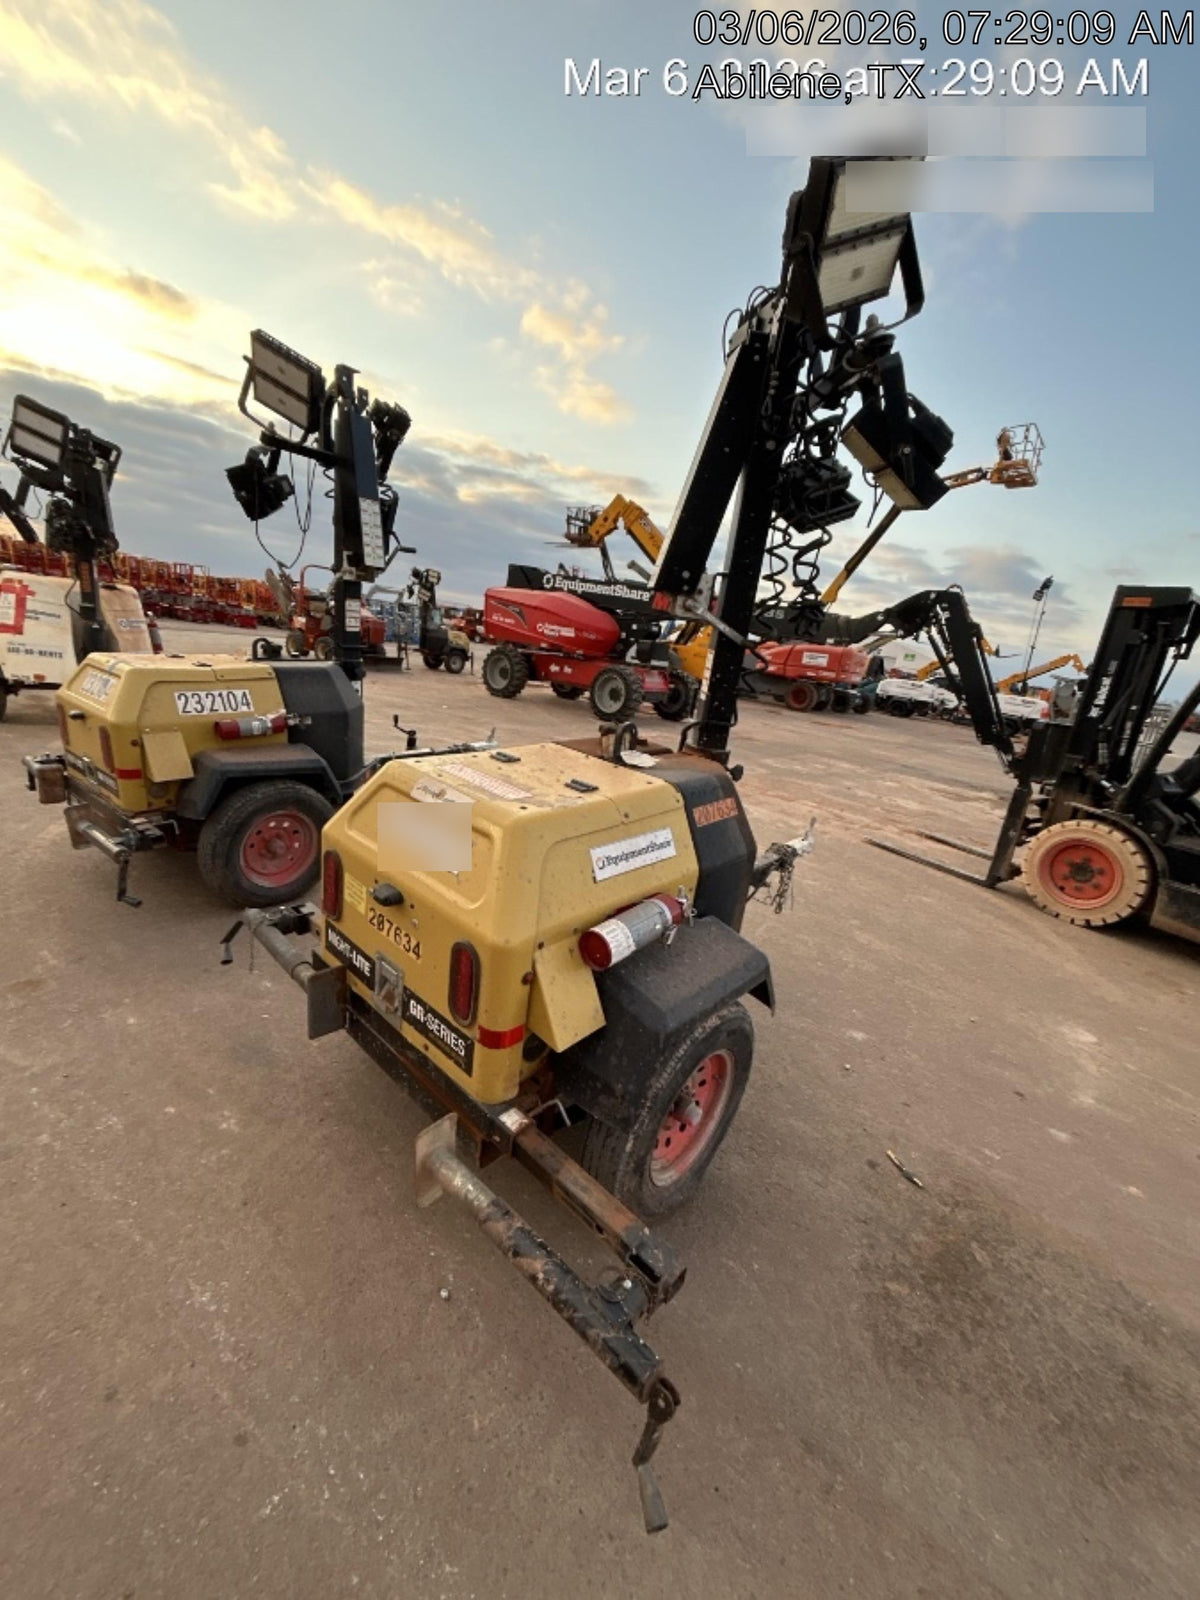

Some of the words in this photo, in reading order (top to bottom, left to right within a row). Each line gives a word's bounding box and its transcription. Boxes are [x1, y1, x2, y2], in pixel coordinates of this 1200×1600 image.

[555, 575, 650, 601] EquipmentShare
[176, 689, 252, 714] 232104
[604, 840, 671, 866] EquipmentShare
[368, 908, 422, 961] 207634
[409, 1000, 466, 1057] GR-SERIES
